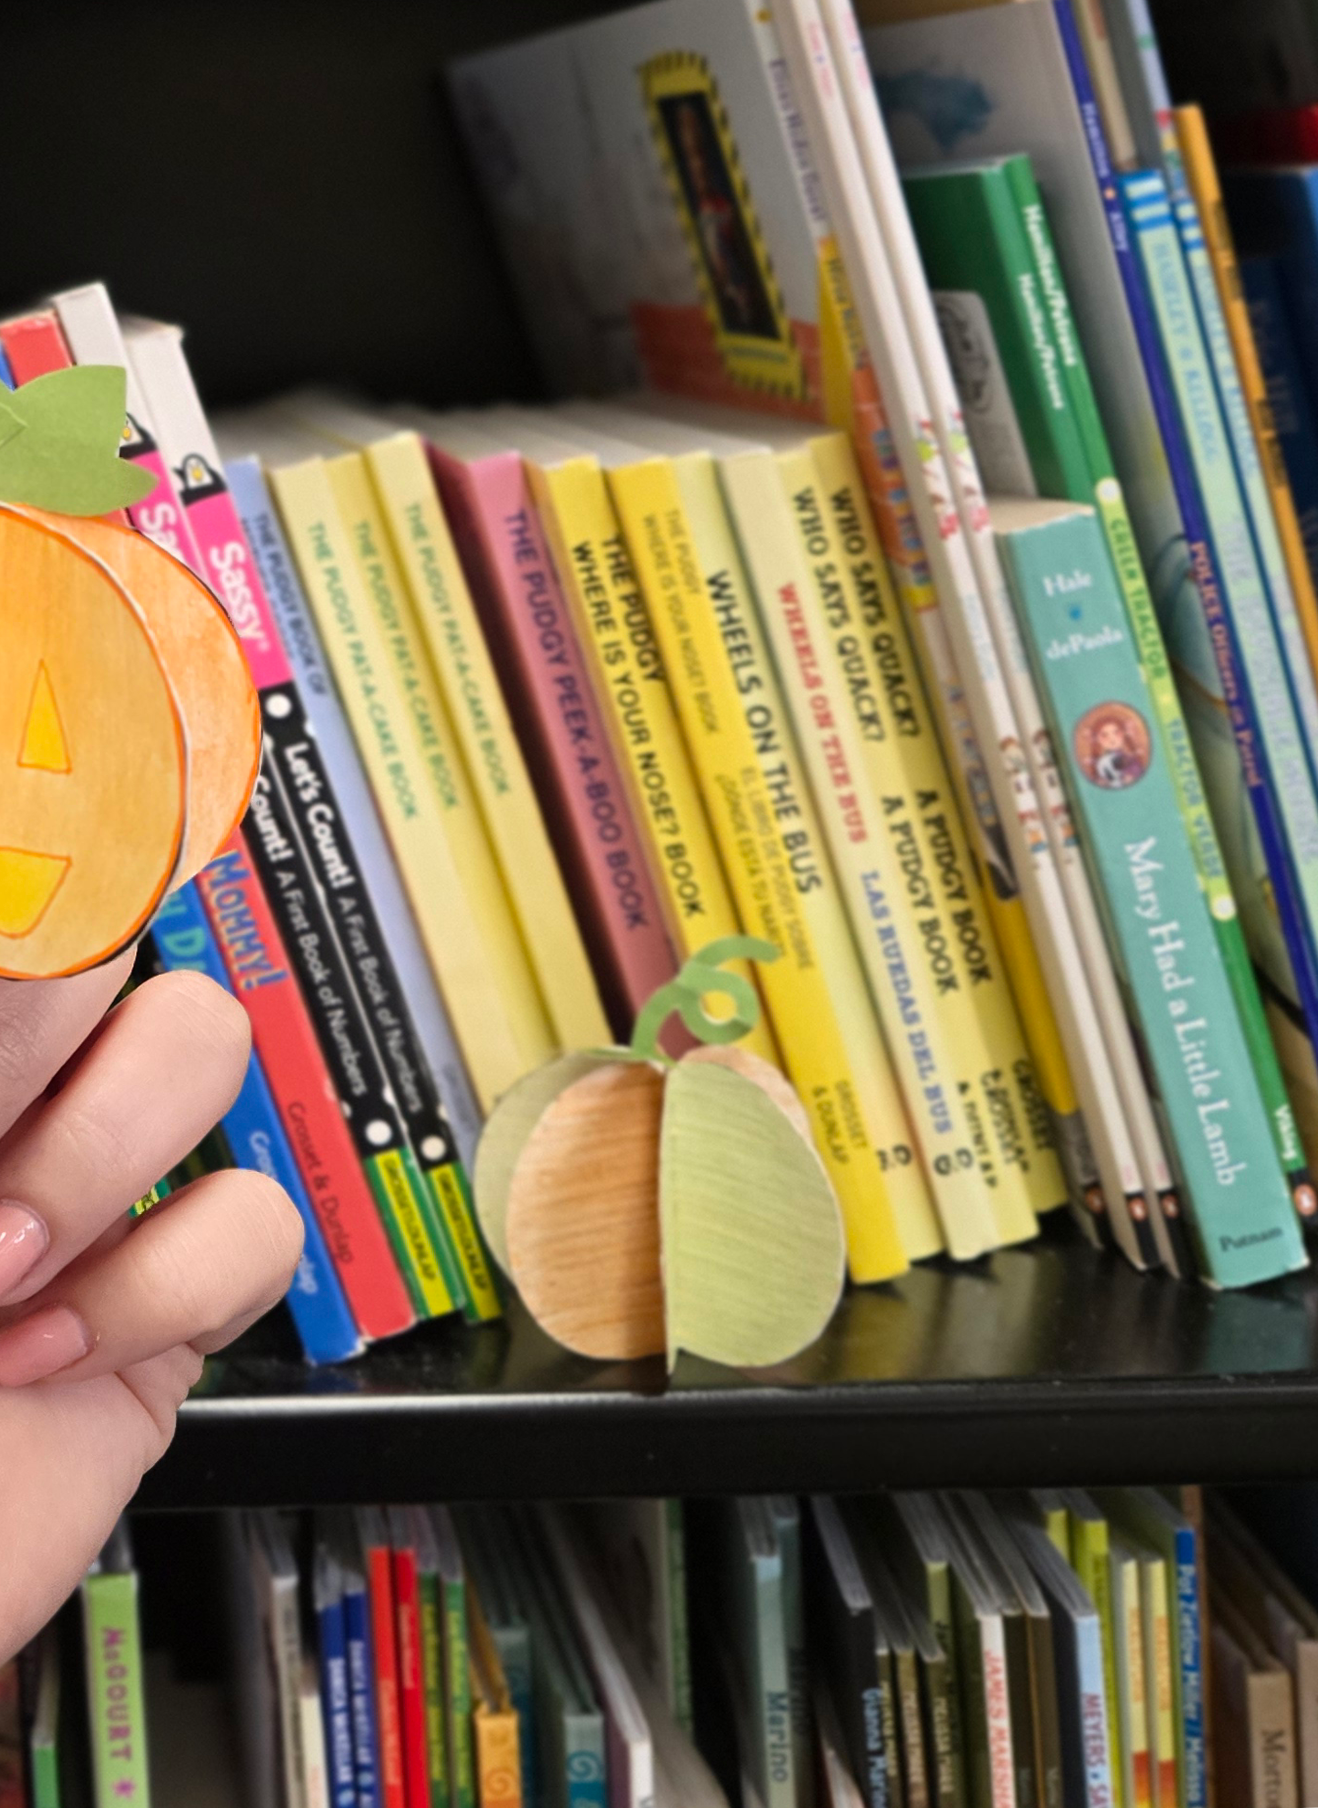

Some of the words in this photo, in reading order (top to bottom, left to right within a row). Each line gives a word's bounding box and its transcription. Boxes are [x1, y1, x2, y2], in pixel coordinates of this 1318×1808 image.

[1017, 201, 1084, 370] Hamilton/Petrone
[1013, 272, 1068, 411] Hamilton/Petrone
[402, 501, 430, 543] THE
[792, 487, 829, 557] WHO
[830, 486, 866, 556] WHO
[1103, 209, 1131, 255] Alley
[1185, 539, 1225, 621] POLICE
[1206, 622, 1246, 702] Officers
[1234, 728, 1265, 787] Patrol
[305, 520, 334, 561] THE
[350, 519, 377, 559] THE
[500, 507, 540, 564] THE
[599, 531, 637, 587] THE
[205, 538, 272, 647] Sassy
[318, 564, 360, 638] PUDGY
[363, 561, 402, 633] PUDGY
[415, 544, 454, 615] PUDGY
[570, 539, 619, 636] WHERE
[811, 562, 851, 631] SAYS
[848, 559, 889, 628] SAYS
[517, 568, 571, 670] PUDGY
[600, 638, 628, 667] IS
[617, 588, 667, 688] PUDGY
[705, 571, 763, 696] WHEELS
[775, 581, 824, 692] WHEELS
[1046, 625, 1124, 661] dePaola
[344, 639, 400, 757] PAT-A-CAKE
[387, 633, 441, 748] PAT-A-CAKE
[439, 617, 494, 734] PAT-A-CAKE
[610, 671, 652, 748] YOUR
[833, 632, 886, 745] QUACK?
[869, 629, 923, 743] QUACK?
[742, 701, 782, 757] ON
[806, 693, 835, 731] ON
[282, 741, 326, 805] Let's
[385, 759, 421, 821] BOOK
[425, 751, 461, 811] BOOK
[478, 736, 513, 795] BOOK
[549, 672, 625, 846] PEEK-A-BOO
[634, 748, 681, 840] NOSE?
[760, 761, 801, 823] THE
[819, 734, 853, 789] THE
[834, 790, 869, 846] BUS
[880, 794, 905, 817] A
[912, 785, 939, 810] A
[302, 800, 356, 890] Count!
[781, 828, 824, 895] BUS
[889, 819, 936, 914] PUDGY
[923, 812, 969, 908] PUDGY
[1107, 516, 1140, 581] GREEN
[1128, 585, 1168, 680] TRACTOR
[1269, 1103, 1301, 1161] Viking
[276, 868, 296, 887] A
[282, 887, 314, 934] First
[336, 894, 357, 914] A
[603, 848, 650, 932] BOOK
[663, 840, 706, 920] BOOK
[858, 868, 891, 920] LAS
[1119, 835, 1174, 922] Mary
[298, 934, 331, 980] Book
[343, 914, 371, 957] First
[915, 916, 960, 998] BOOK
[949, 907, 994, 990] BOOK
[1146, 920, 1195, 992] Had
[317, 982, 341, 1008] of
[357, 956, 388, 1003] Book
[874, 923, 922, 1028] RUEDAS
[1166, 997, 1187, 1017] a
[323, 1007, 372, 1097] Numbers
[374, 1005, 398, 1031] of
[382, 1029, 426, 1112] Numbers
[905, 1028, 939, 1082] DEL
[1172, 1016, 1224, 1100] Little
[921, 1083, 955, 1136] BUS
[1195, 1097, 1249, 1187] Lamb
[283, 1098, 327, 1173] Grosset
[313, 1194, 359, 1266] Dunlap
[1218, 1224, 1284, 1254] Putnam
[984, 1649, 1007, 1720] JAMES
[1082, 1692, 1107, 1768] MEYERS
